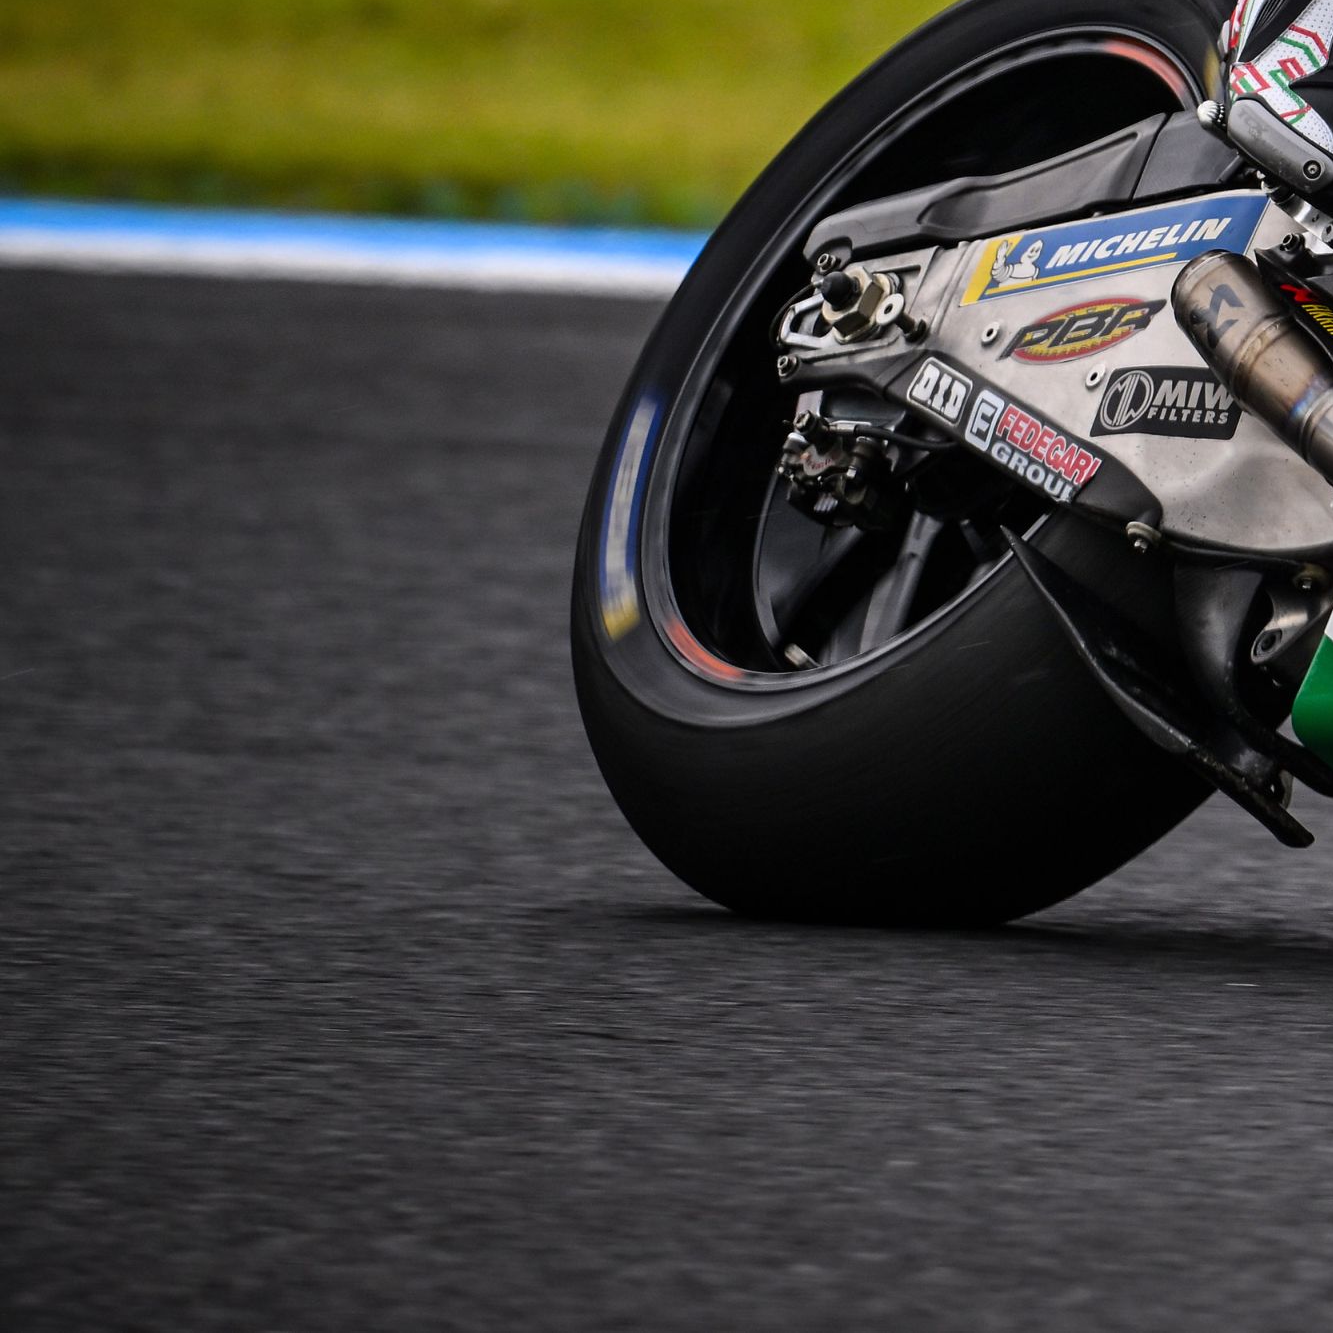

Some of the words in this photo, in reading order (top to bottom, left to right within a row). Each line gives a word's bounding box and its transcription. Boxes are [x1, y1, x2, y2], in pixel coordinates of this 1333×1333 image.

[1045, 218, 1232, 269] MICHELIN
[997, 298, 1167, 361] PBR
[912, 363, 968, 420] D.I.D
[1148, 407, 1230, 426] FILTERS
[1151, 378, 1237, 409] MIW
[996, 403, 1102, 485] FEDEGARI
